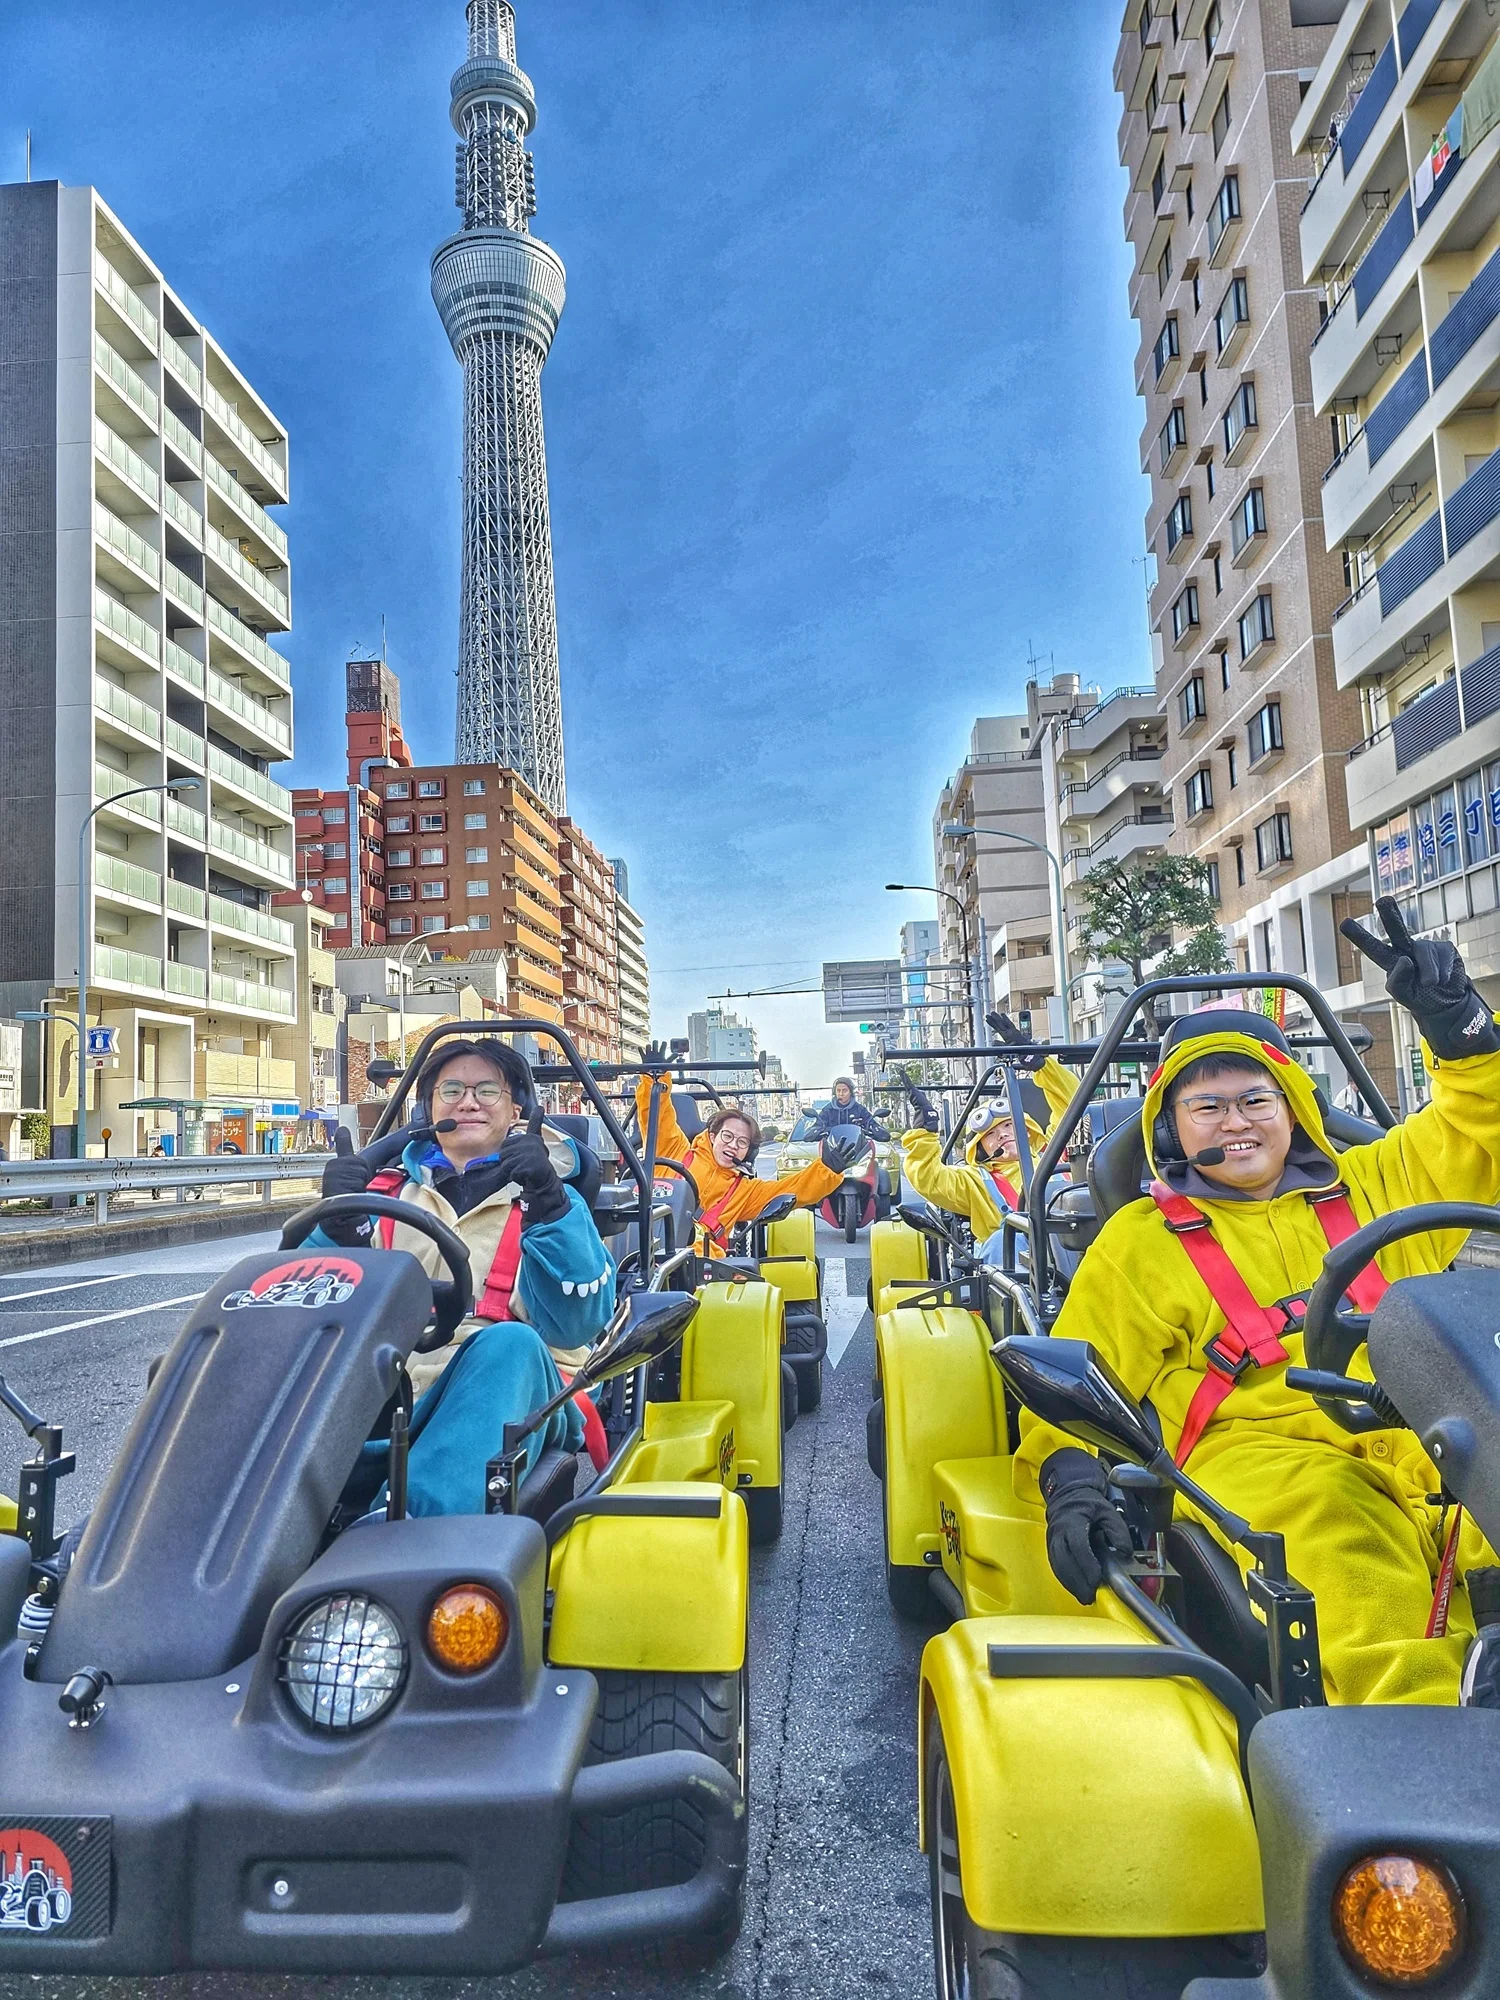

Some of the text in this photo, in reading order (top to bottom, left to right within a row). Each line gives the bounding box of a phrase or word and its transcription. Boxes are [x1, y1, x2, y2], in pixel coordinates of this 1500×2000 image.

[212, 1127, 243, 1137] カーセンサー
